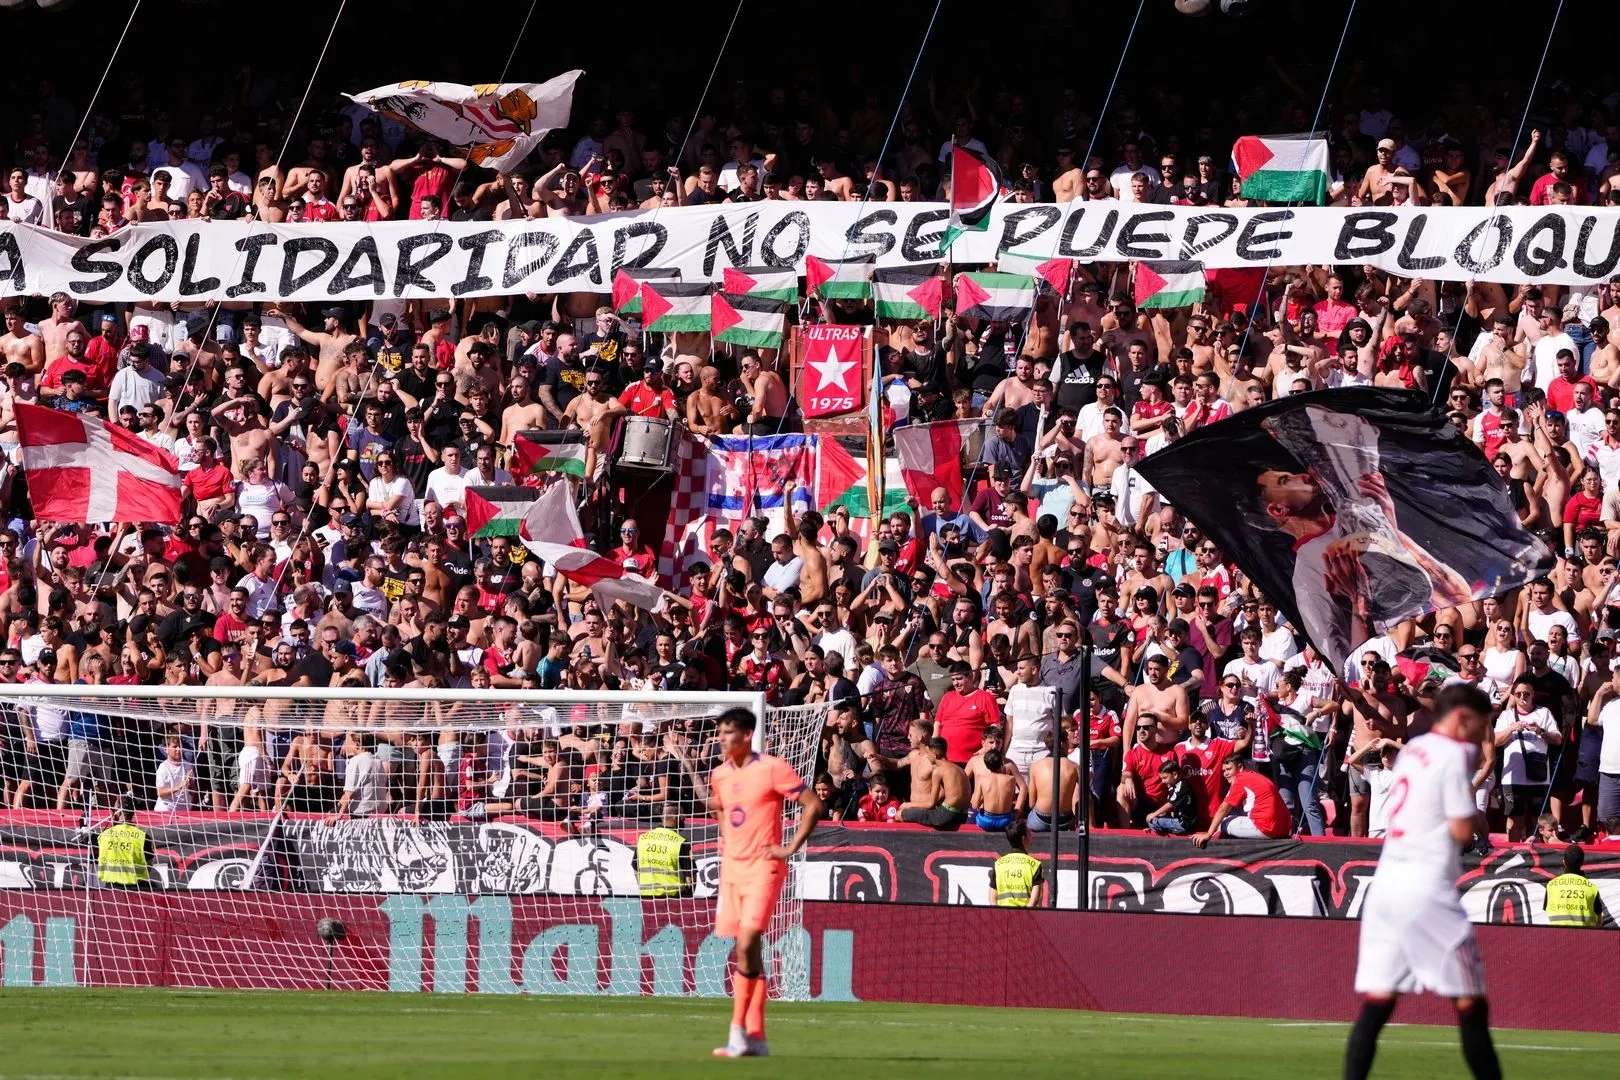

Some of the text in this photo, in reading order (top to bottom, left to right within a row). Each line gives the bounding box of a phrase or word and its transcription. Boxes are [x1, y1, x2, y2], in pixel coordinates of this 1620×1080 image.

[703, 210, 811, 278] NO
[845, 209, 951, 261] SE
[995, 206, 1296, 261] PUEDE
[1334, 211, 1620, 279] BLOQU
[808, 327, 860, 341] ULTRAS
[1064, 375, 1095, 384] adidas
[810, 397, 854, 410] 1975
[1389, 776, 1409, 838] 2
[646, 843, 668, 855] 2033
[1549, 877, 1593, 888] SEGURIDAD
[1560, 889, 1585, 900] 2253
